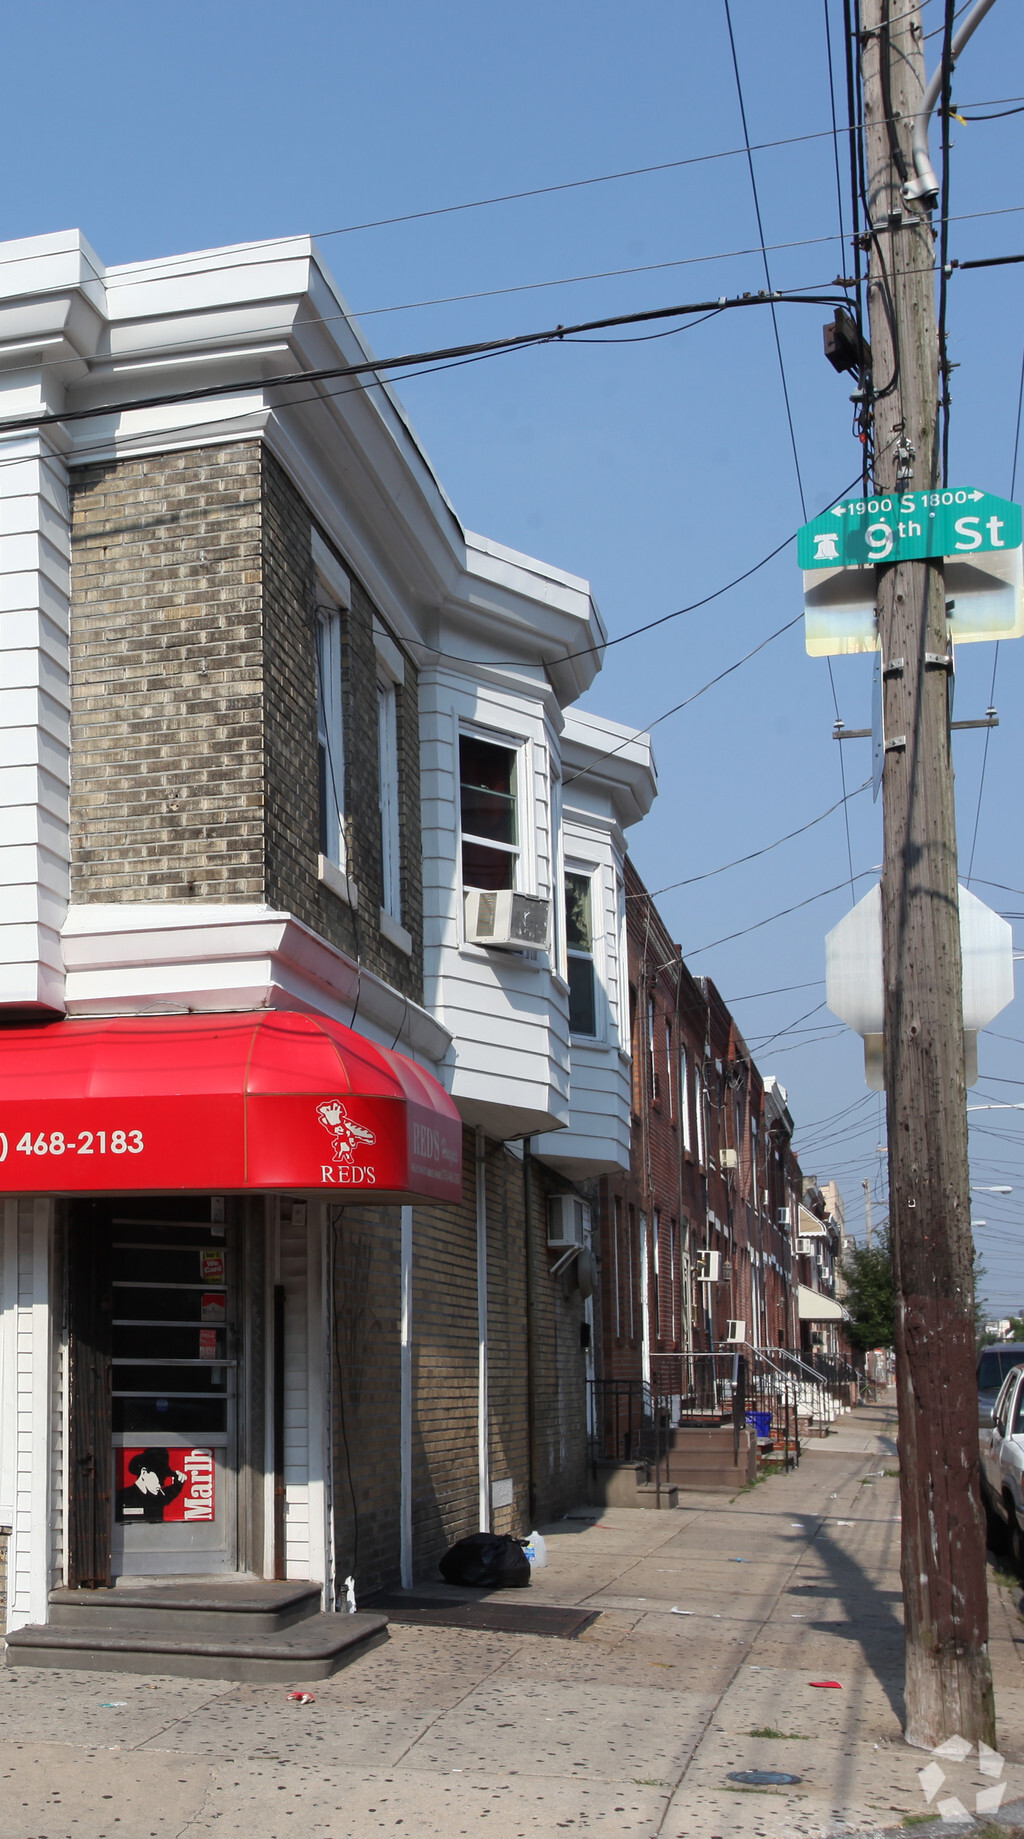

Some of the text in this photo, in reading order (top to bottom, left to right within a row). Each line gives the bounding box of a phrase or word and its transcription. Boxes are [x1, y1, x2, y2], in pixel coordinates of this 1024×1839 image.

[848, 490, 967, 516] 1900 S 1800
[865, 515, 1005, 559] 9th St
[16, 1130, 145, 1155] 468-2183
[320, 1165, 376, 1184] RED'S
[184, 1448, 213, 1520] Marlb
